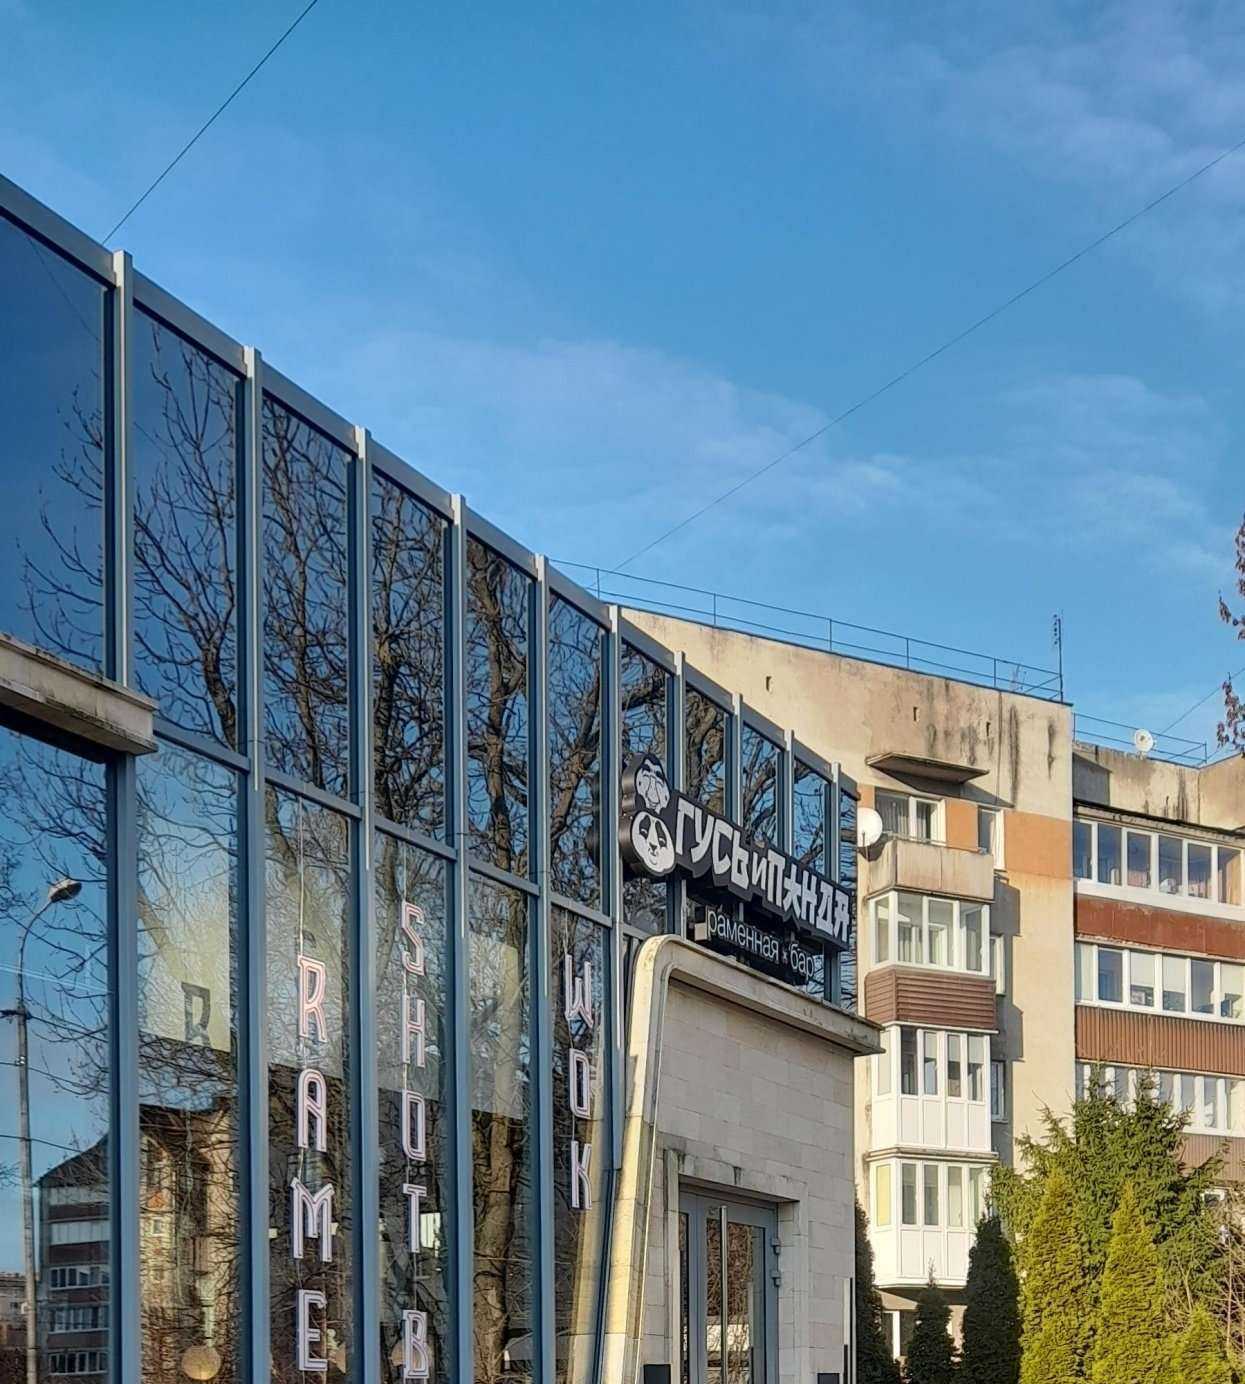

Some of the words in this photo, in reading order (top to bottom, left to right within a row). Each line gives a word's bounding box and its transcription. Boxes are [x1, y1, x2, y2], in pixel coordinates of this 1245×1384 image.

[675, 796, 750, 890] ГУСЬ
[706, 908, 779, 962] раменная
[789, 942, 815, 979] бар
[402, 900, 427, 1253] SHOT
[565, 953, 593, 1210] WOK
